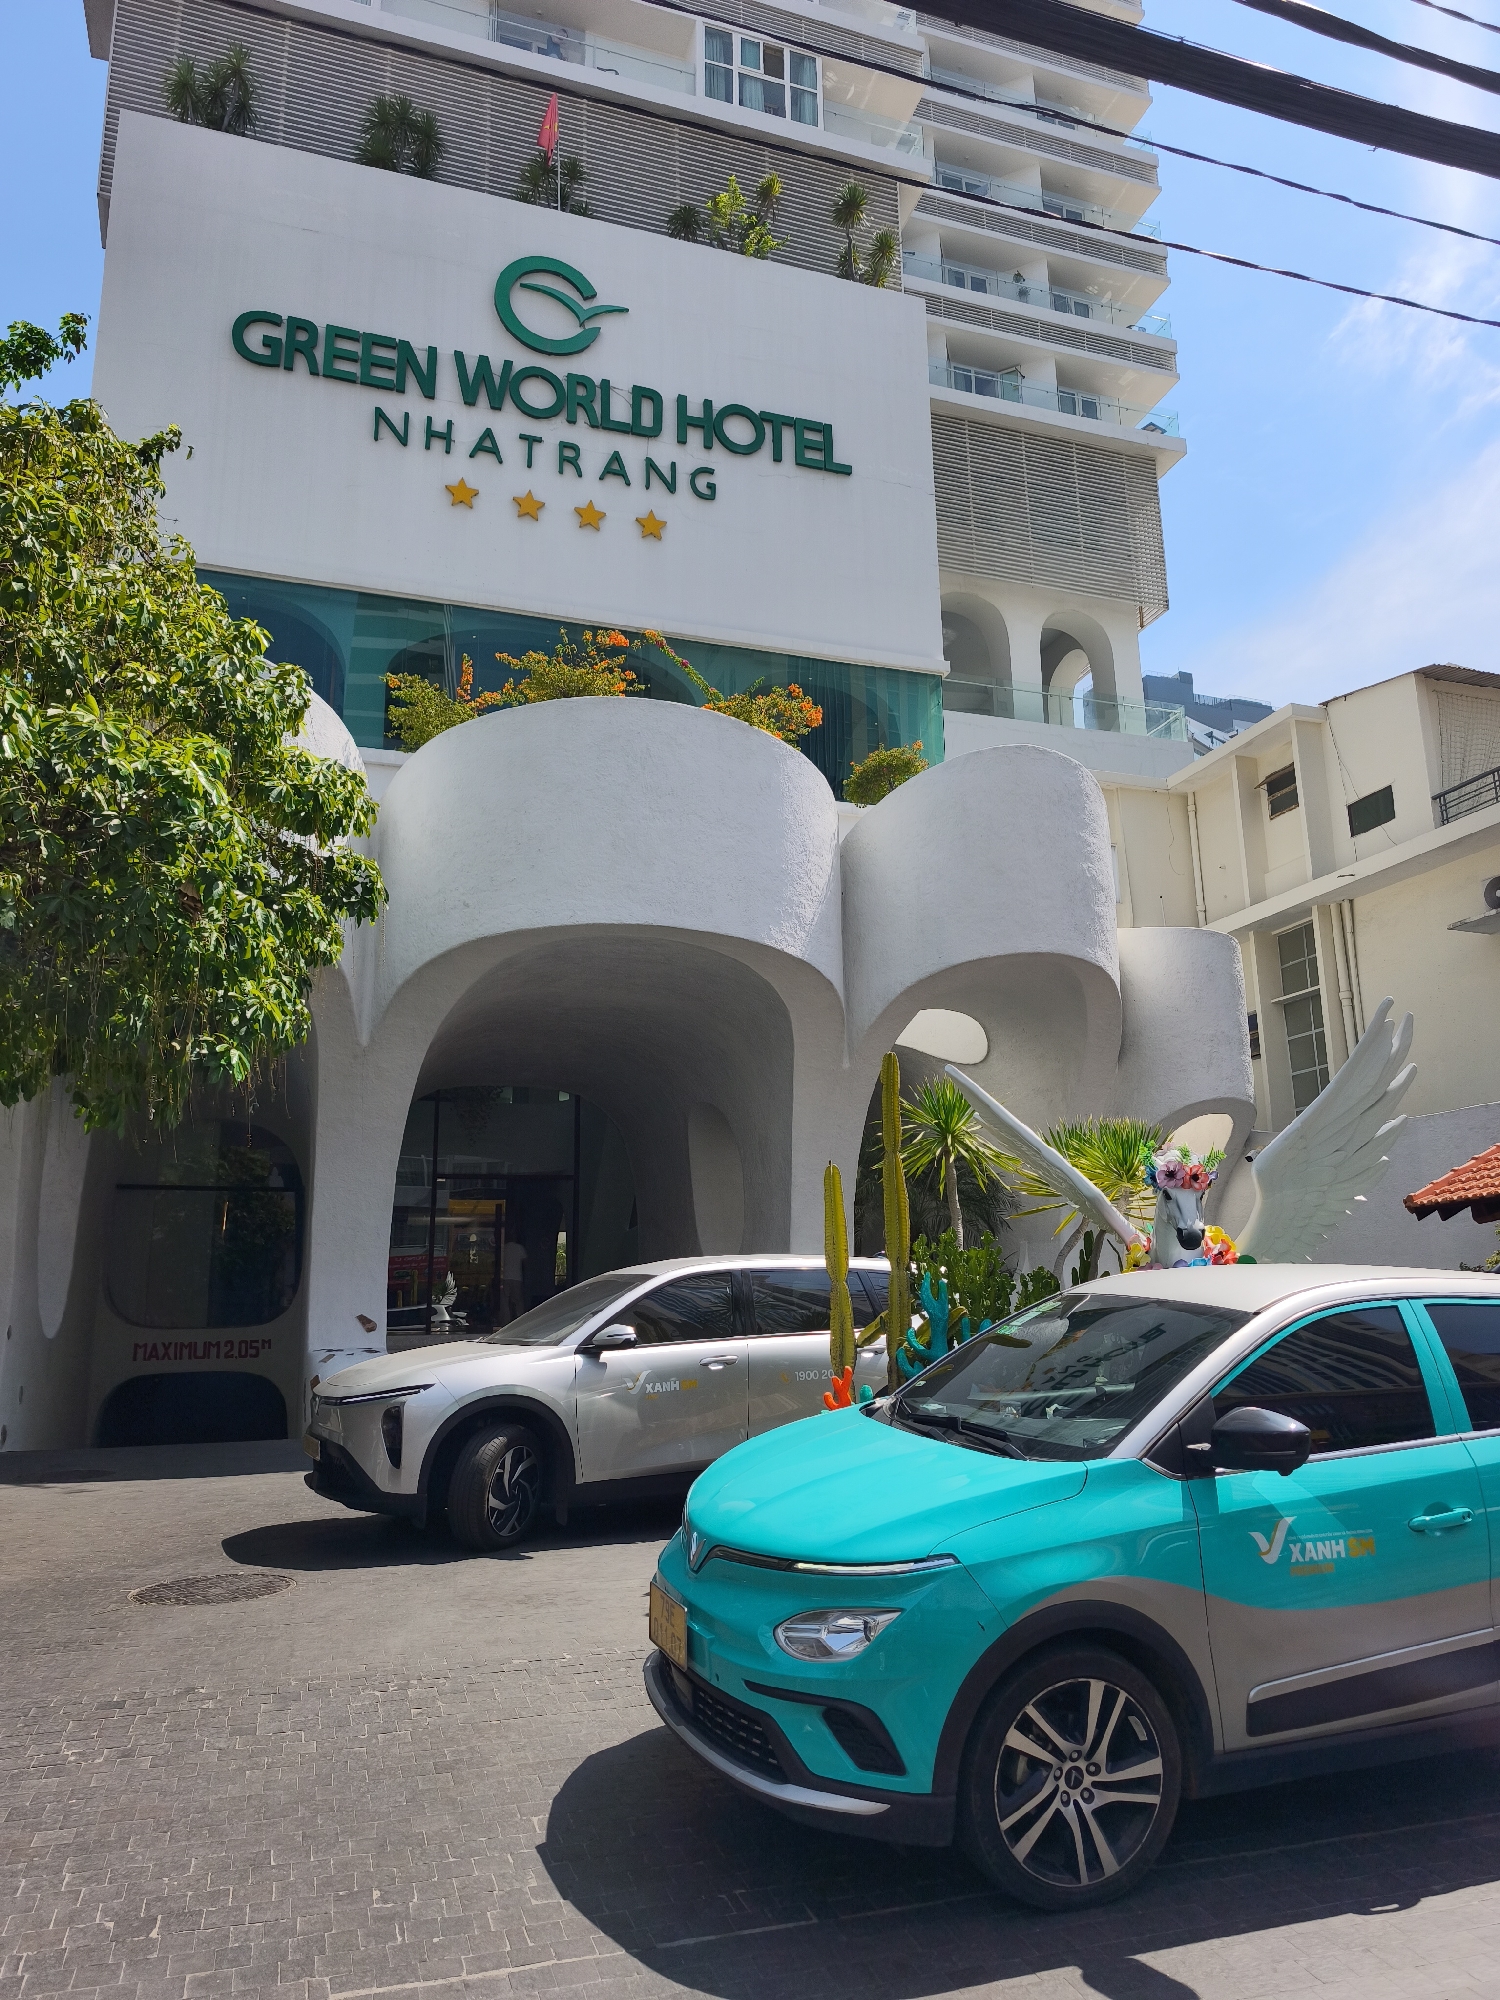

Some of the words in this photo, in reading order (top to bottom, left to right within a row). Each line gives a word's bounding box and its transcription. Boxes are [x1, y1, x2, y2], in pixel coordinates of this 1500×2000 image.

[232, 310, 438, 399] GREEN
[454, 349, 664, 438] WORLD
[676, 393, 853, 476] HOTEL
[373, 406, 717, 501] NHATRANG
[133, 1342, 220, 1361] MAXIMUM
[645, 1380, 680, 1394] XANH
[680, 1379, 698, 1391] SM
[794, 1370, 819, 1381] 1900
[1288, 1539, 1345, 1562] XANH
[1347, 1536, 1376, 1558] SM
[660, 1594, 675, 1628] 79E
